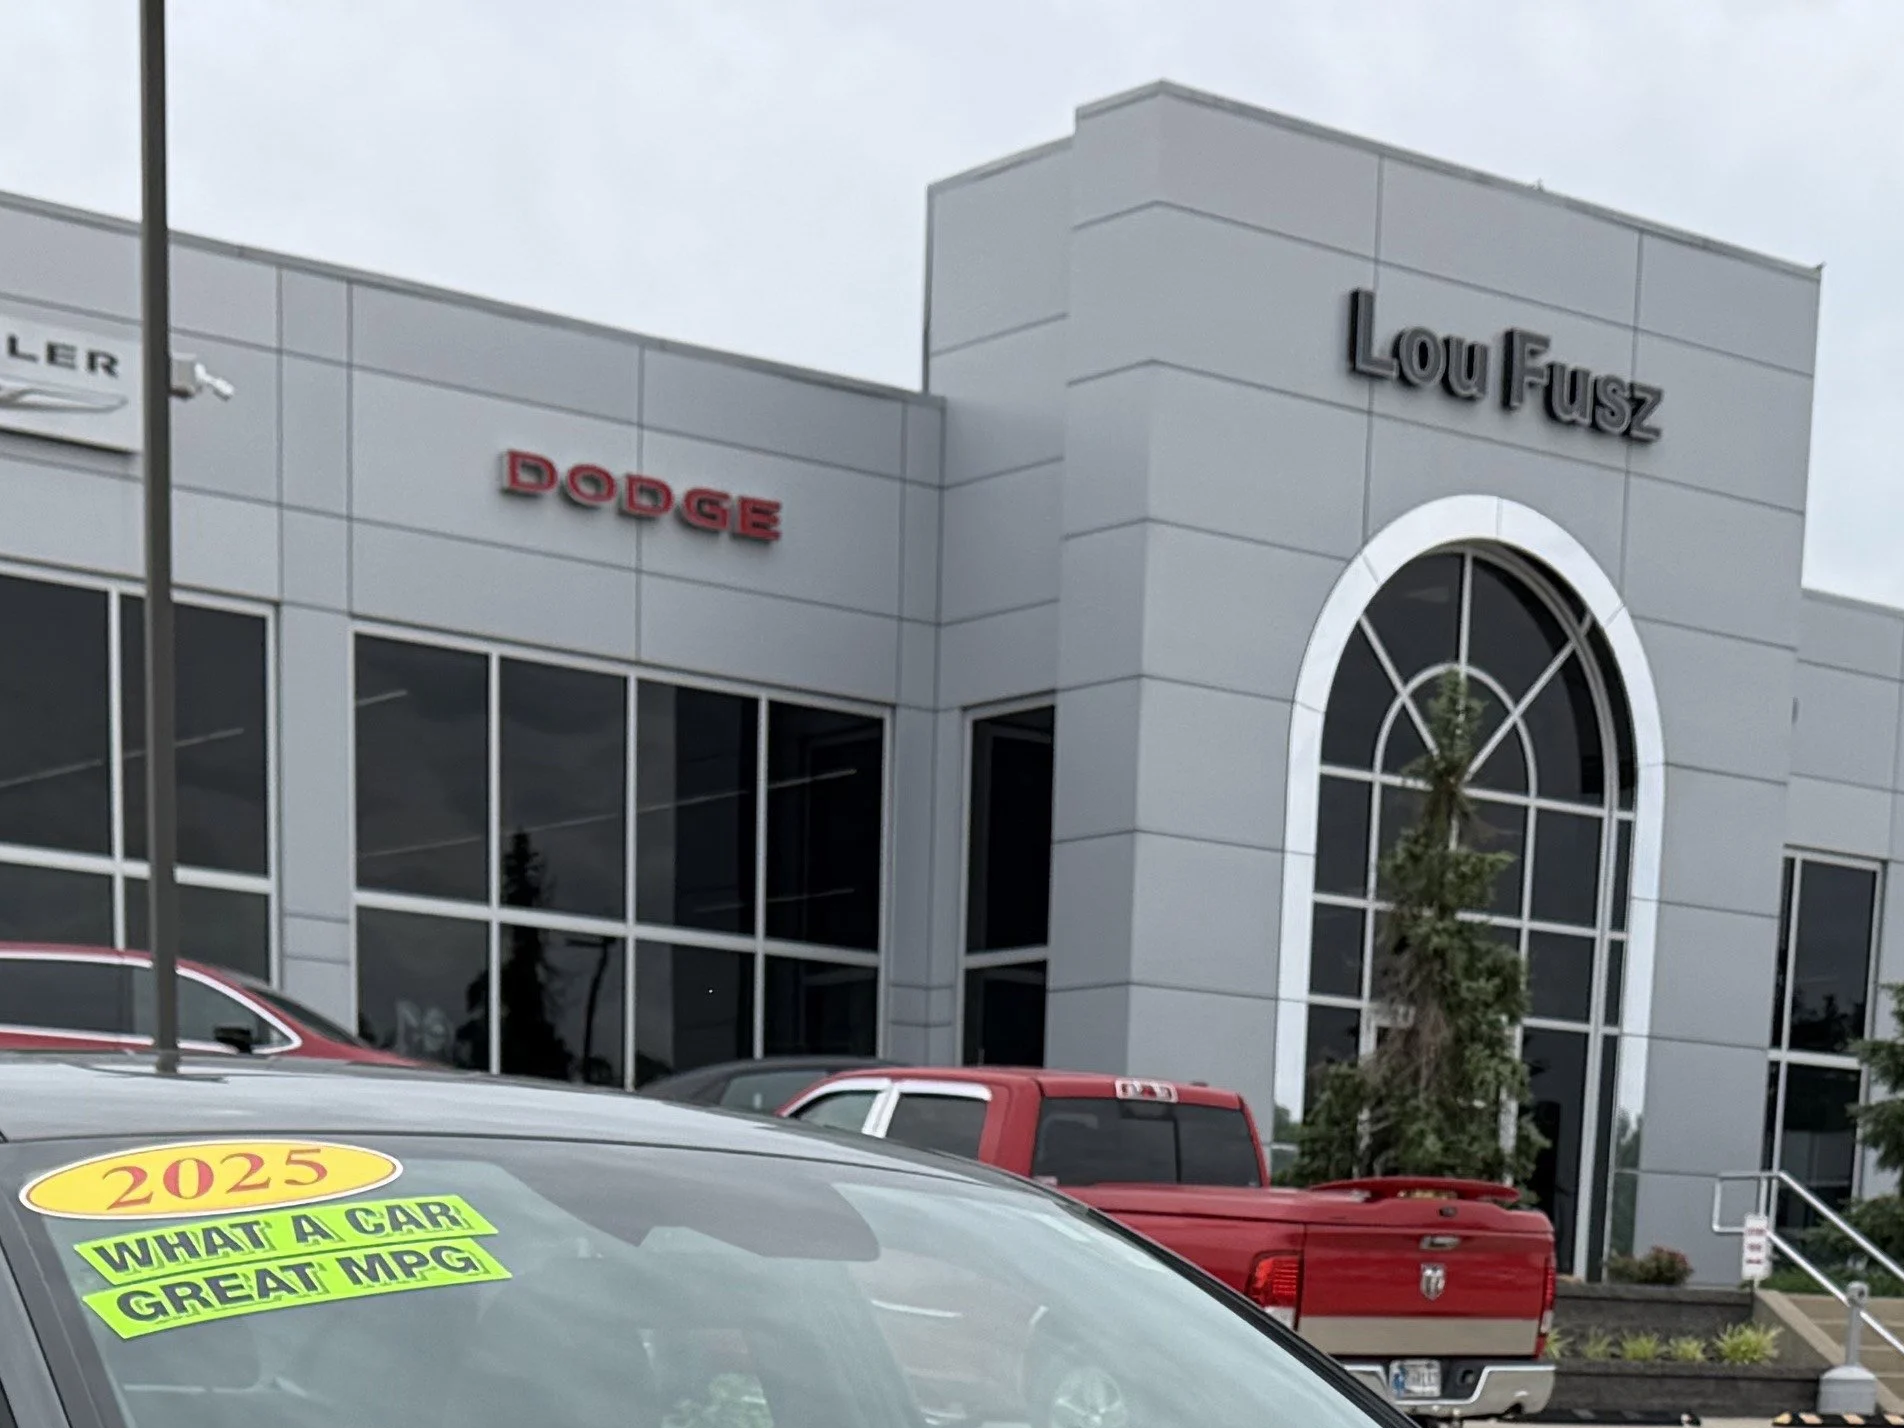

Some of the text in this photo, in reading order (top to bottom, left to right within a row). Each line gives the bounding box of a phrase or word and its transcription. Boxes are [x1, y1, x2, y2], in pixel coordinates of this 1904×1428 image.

[1348, 287, 1663, 442] Lou Fusz
[501, 449, 782, 541] DODGE
[101, 1148, 328, 1211] 2025
[93, 1200, 467, 1275] WHAT A CAR
[116, 1245, 482, 1322] GREAT MPG
